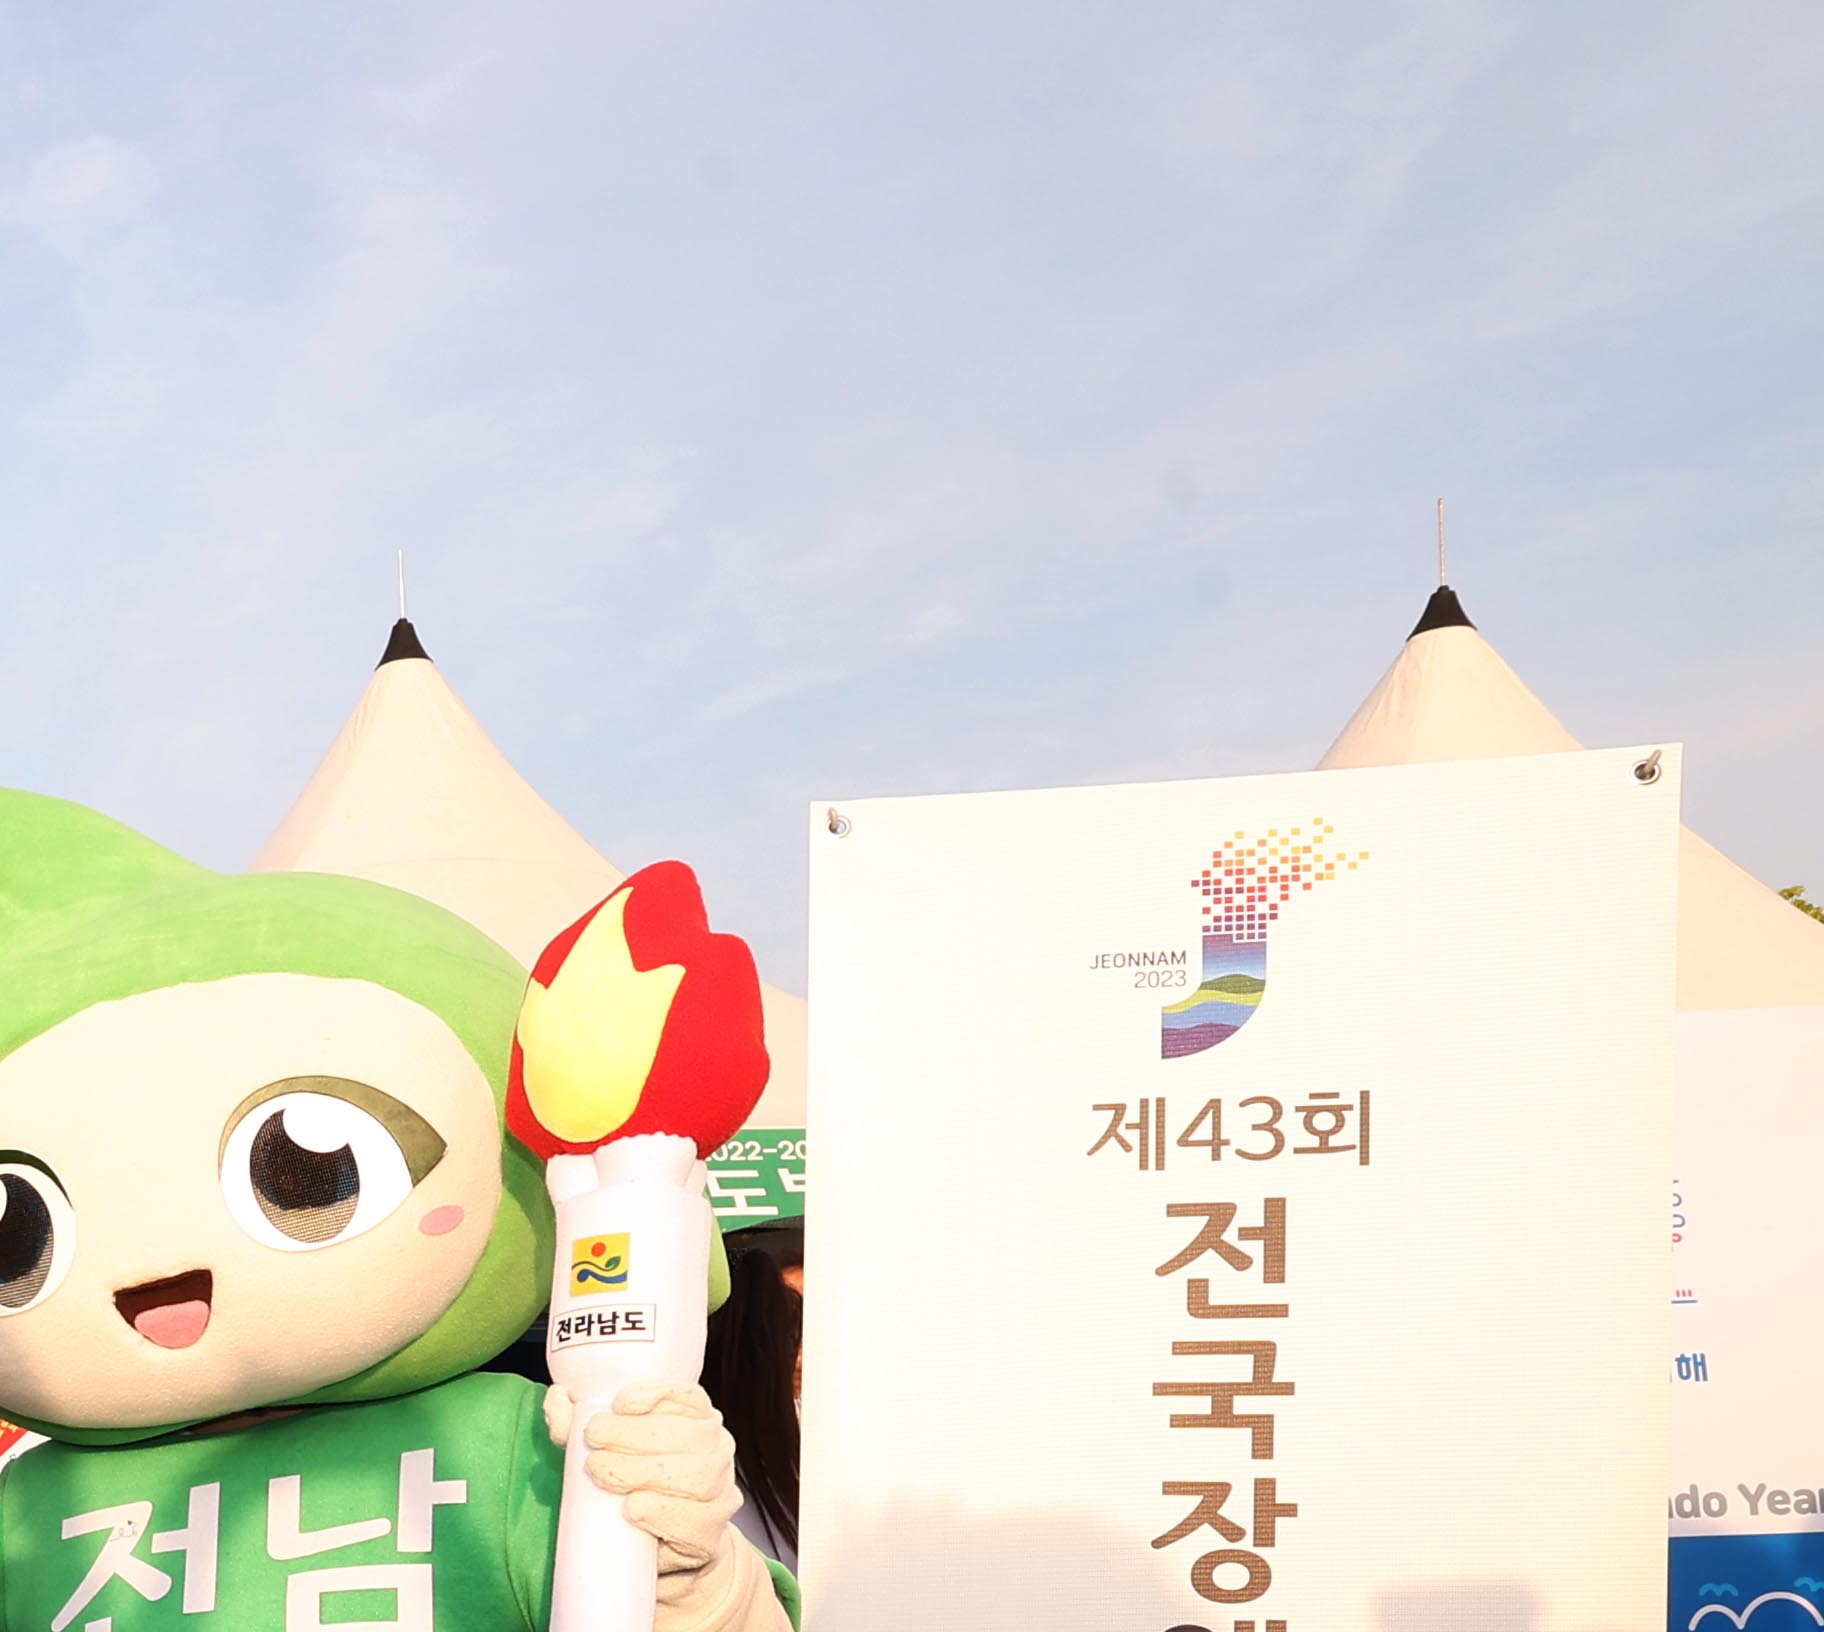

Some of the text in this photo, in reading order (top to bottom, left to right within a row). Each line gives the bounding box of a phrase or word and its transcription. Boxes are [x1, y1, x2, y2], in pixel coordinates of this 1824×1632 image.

[1089, 949, 1188, 970] JEONNAM
[1134, 969, 1188, 990] 2023
[1086, 1090, 1372, 1171] 제43회
[556, 1311, 646, 1343] 전라남도
